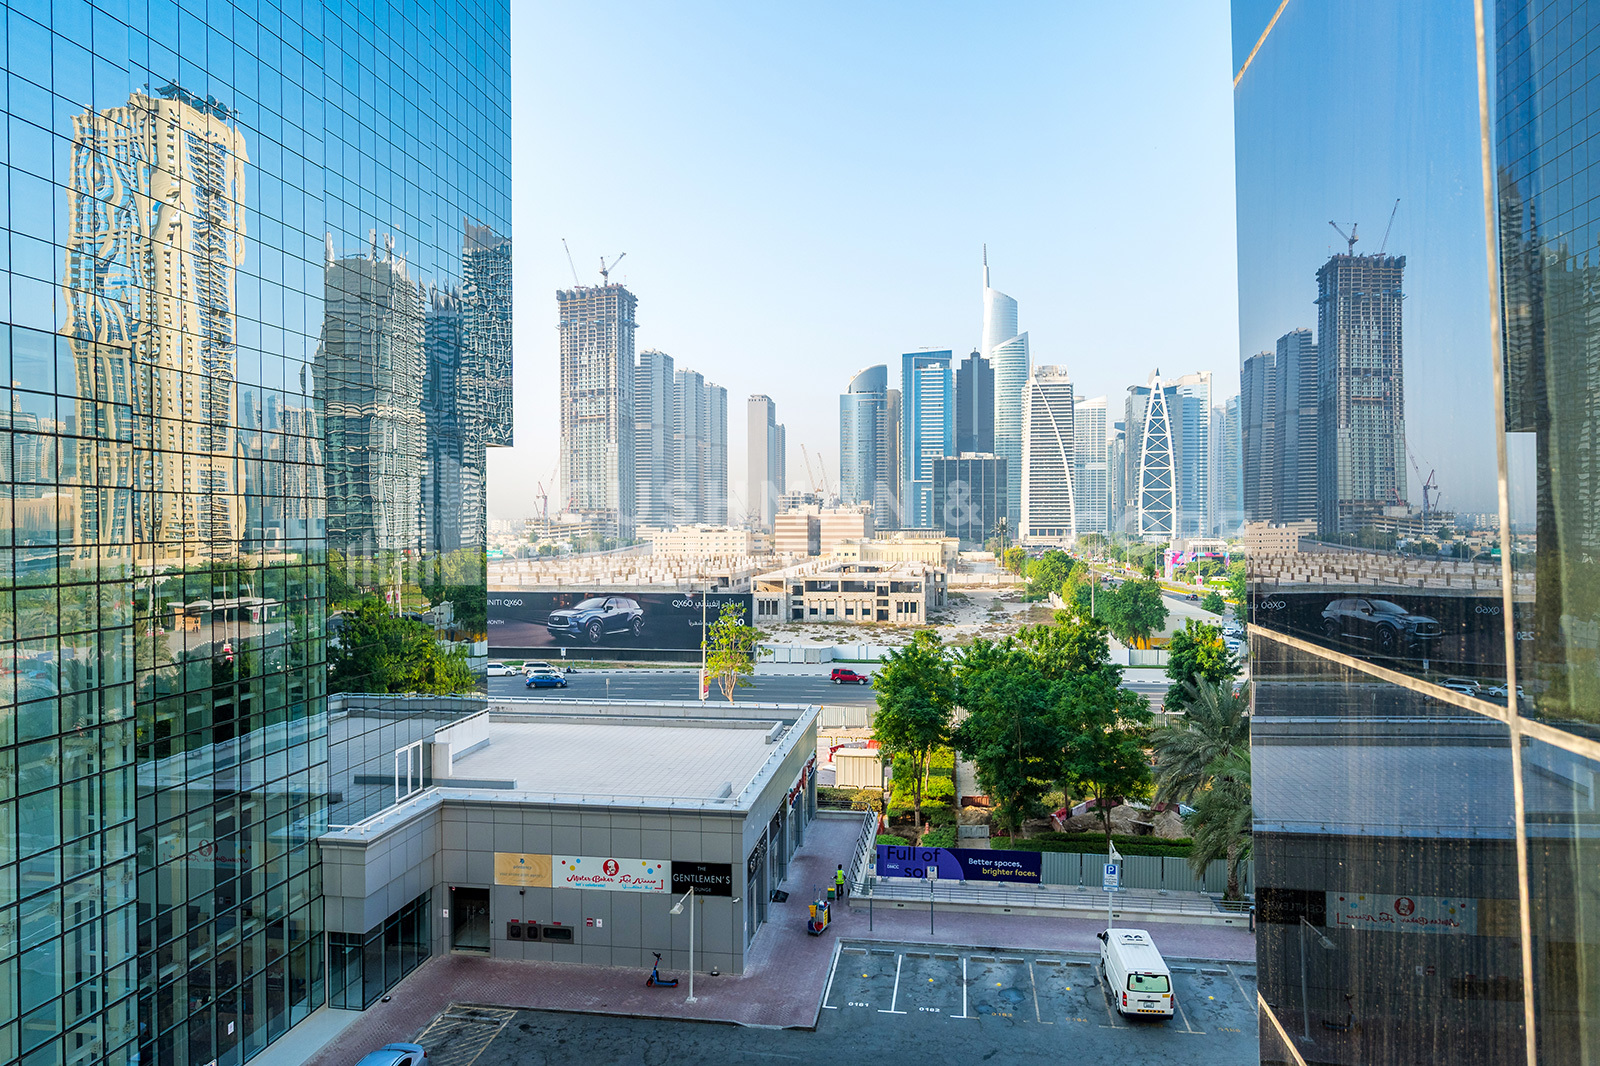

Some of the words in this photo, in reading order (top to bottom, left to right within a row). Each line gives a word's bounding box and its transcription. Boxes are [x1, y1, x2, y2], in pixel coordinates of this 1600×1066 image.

[503, 599, 523, 608] QX60
[672, 599, 694, 608] QX60
[887, 846, 916, 861] Full
[922, 848, 941, 862] of
[968, 857, 993, 866] Better
[994, 860, 1023, 869] spaces,
[982, 867, 1014, 877] brighter
[1015, 868, 1038, 877] faces.
[672, 873, 731, 885] GENTLEMEN'S
